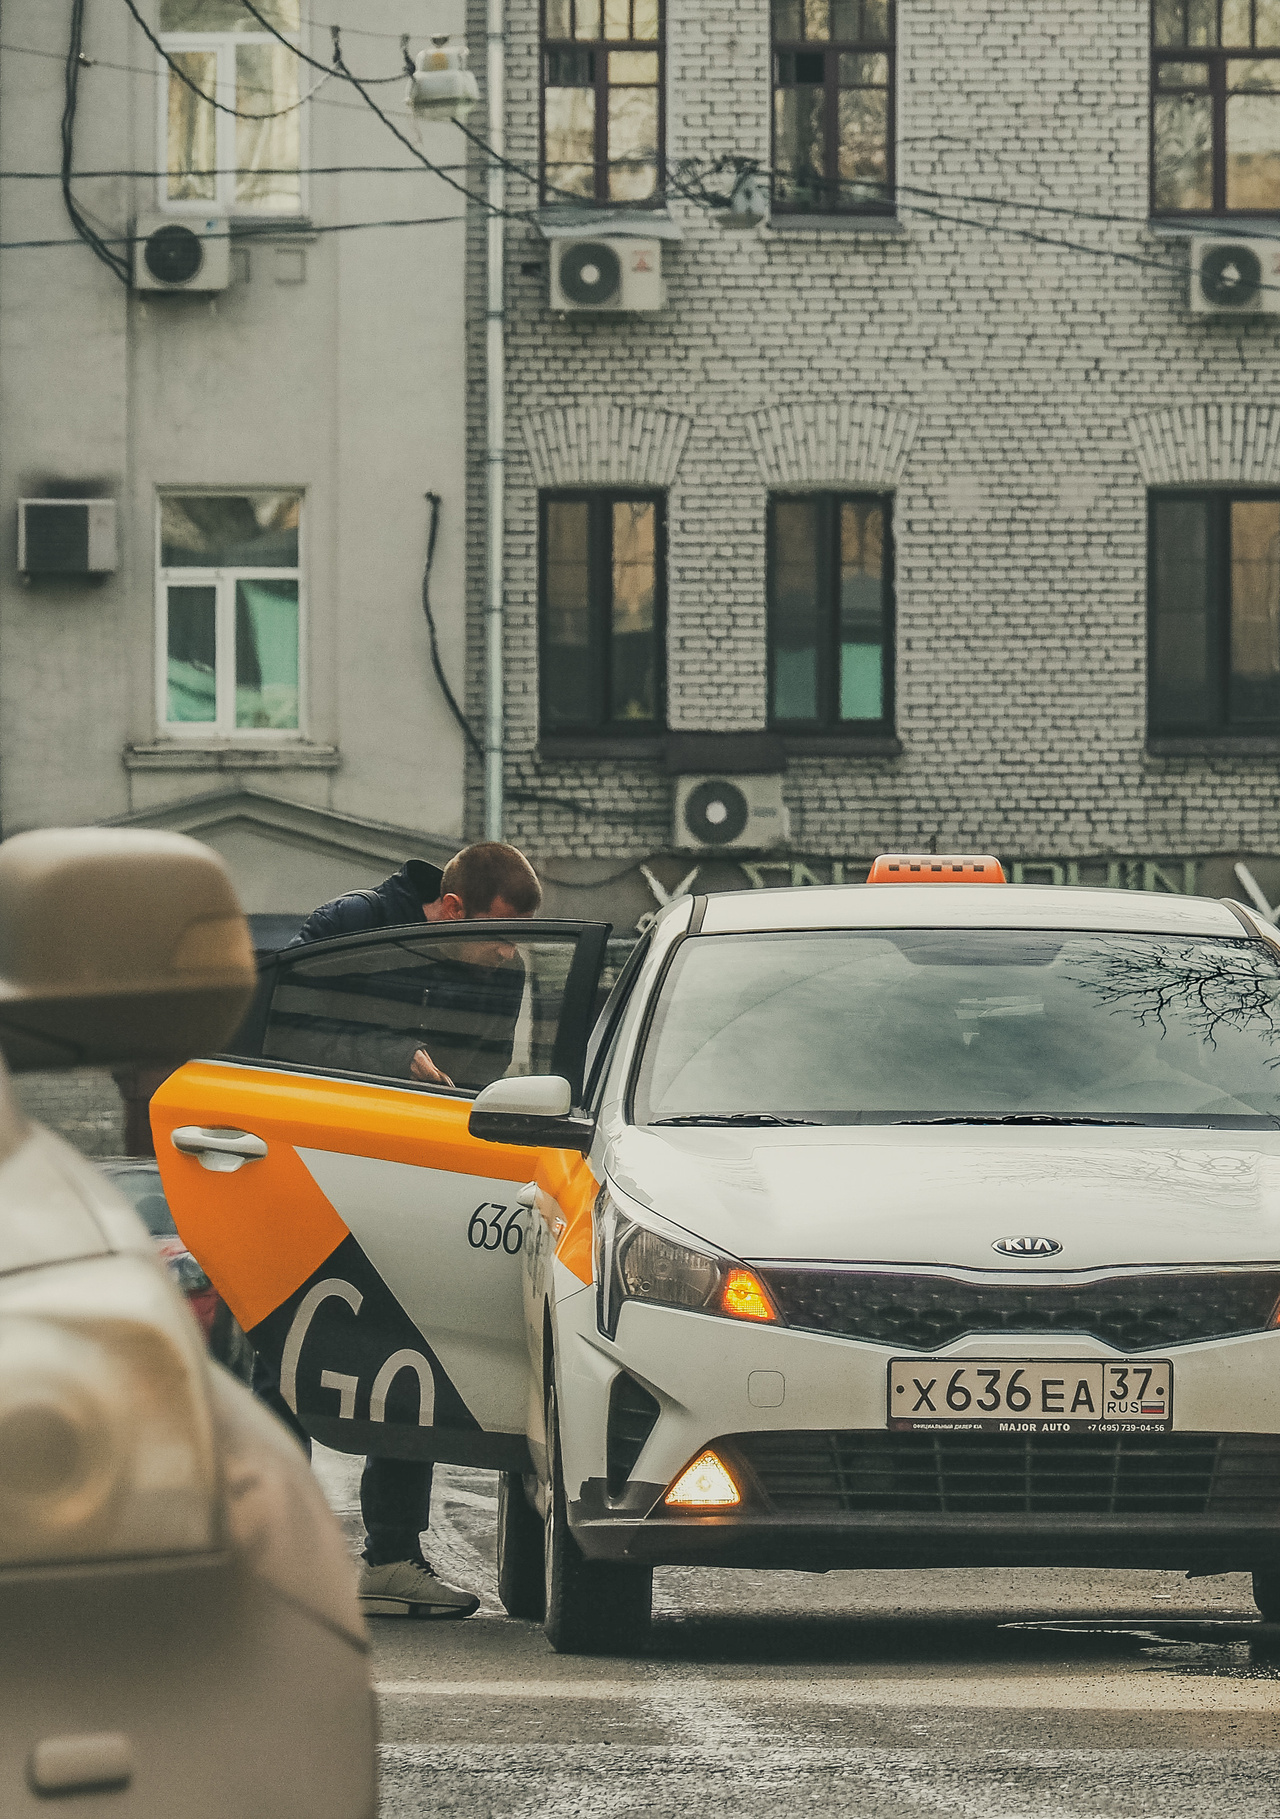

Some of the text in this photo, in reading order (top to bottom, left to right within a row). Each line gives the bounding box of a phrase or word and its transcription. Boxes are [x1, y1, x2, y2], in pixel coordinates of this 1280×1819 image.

[467, 1202, 526, 1255] 636
[1003, 1238, 1053, 1251] KIA
[1110, 1367, 1153, 1401] 37
[1107, 1402, 1140, 1414] RUS
[999, 1422, 1071, 1432] MAJOR AUTO
[1098, 1423, 1120, 1432] (495)
[1121, 1424, 1165, 1432] 739-04-56
